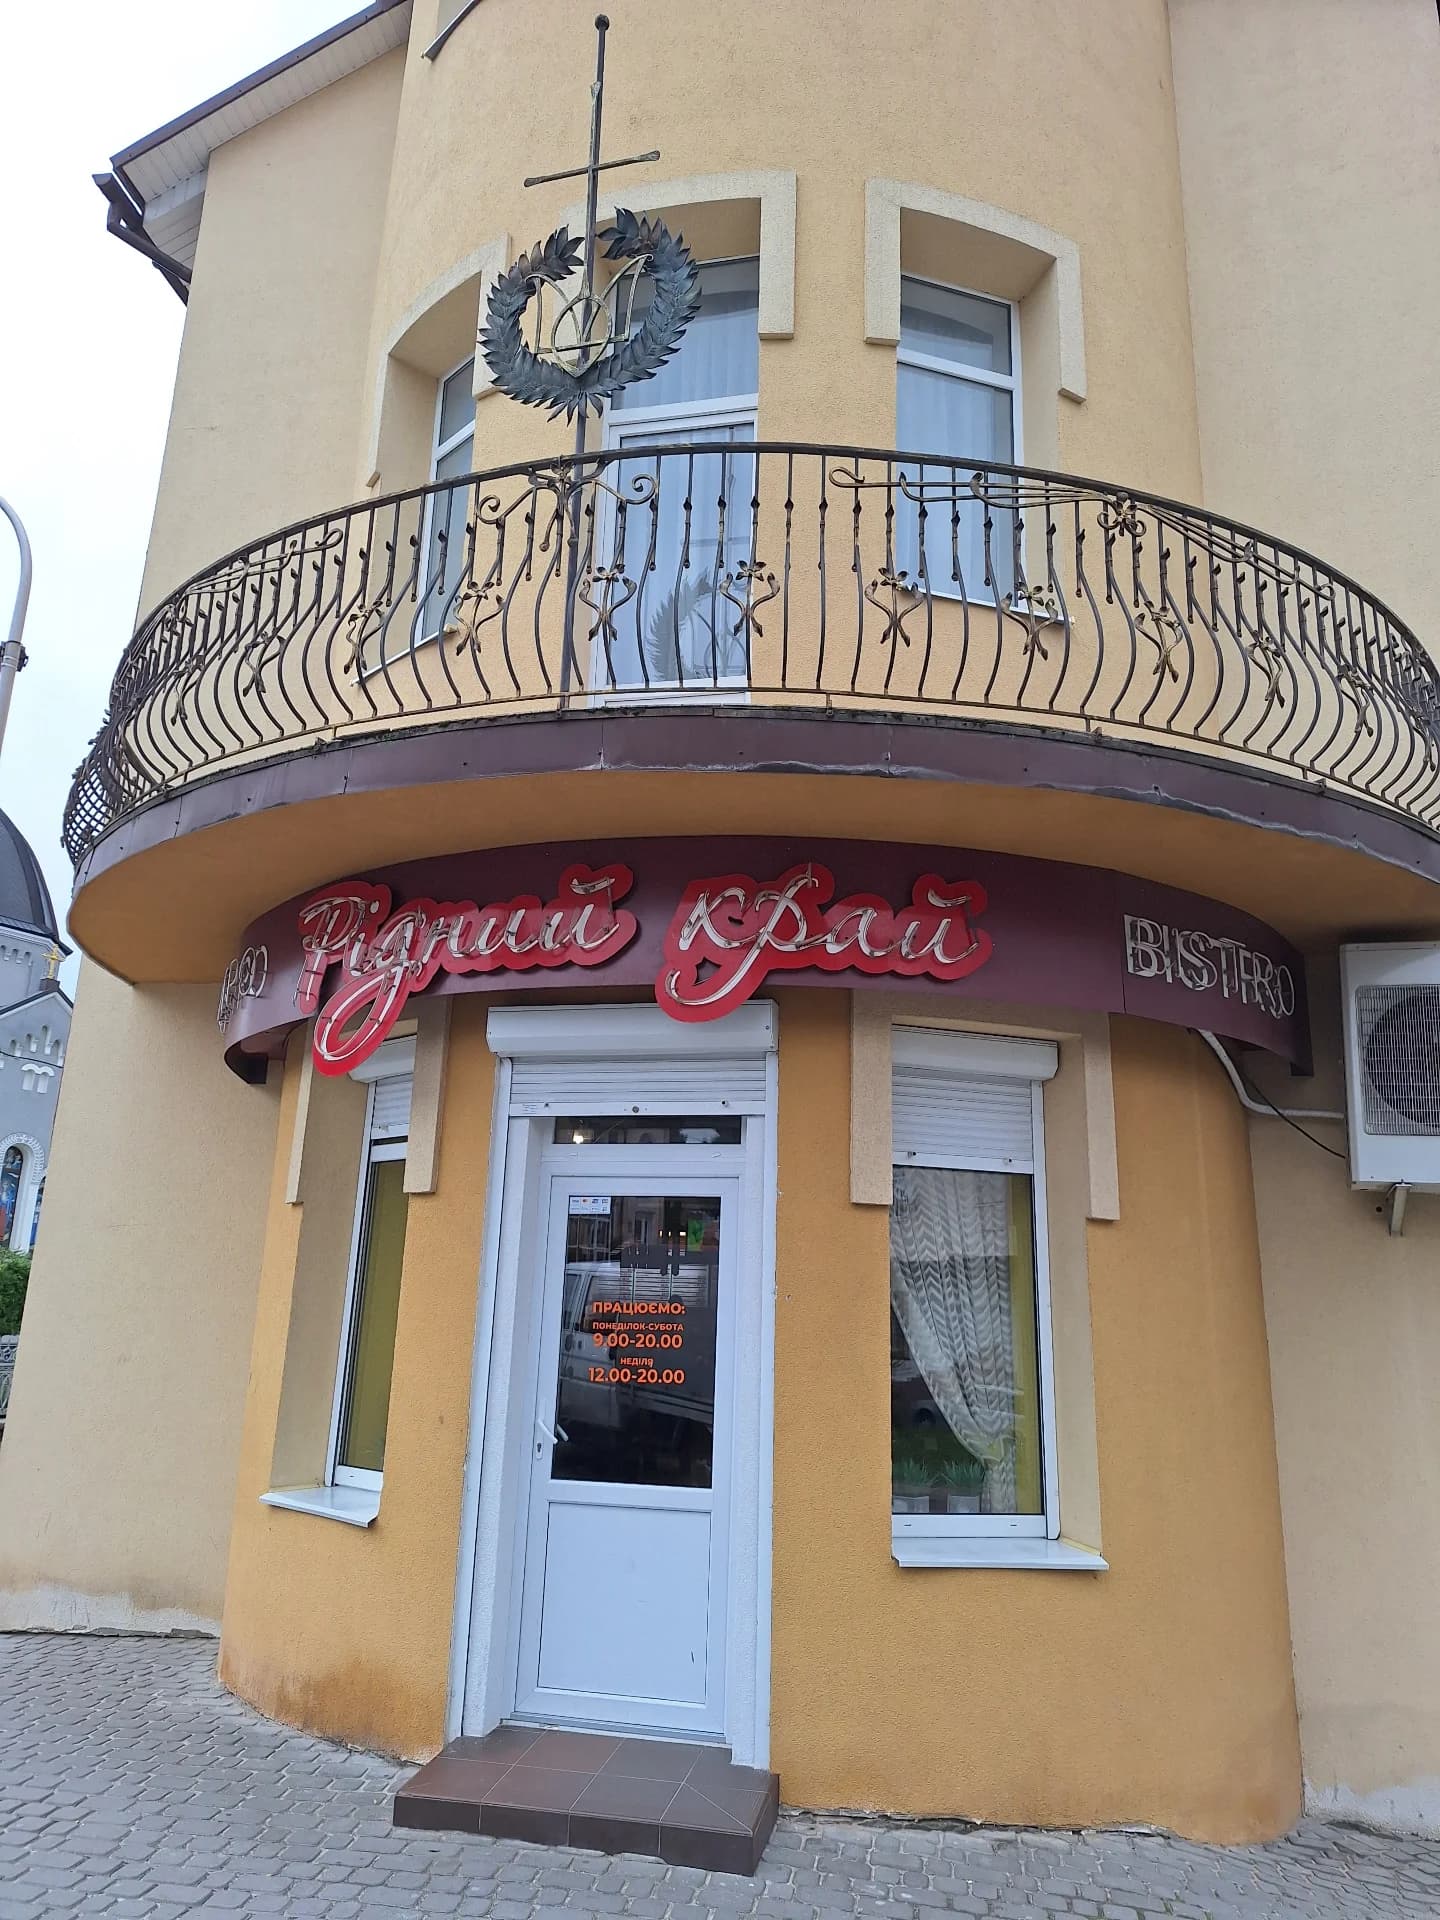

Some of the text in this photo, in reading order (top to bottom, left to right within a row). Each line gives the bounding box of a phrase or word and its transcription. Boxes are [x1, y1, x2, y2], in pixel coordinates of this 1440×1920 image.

[1123, 914, 1295, 1019] BISTRO
[592, 1301, 686, 1315] ПРАЦЮЄМО:
[592, 1333, 683, 1348] 9.00-20.00
[620, 1357, 654, 1367] НЕДІЛЯ
[588, 1367, 685, 1384] 12.00-20.00
